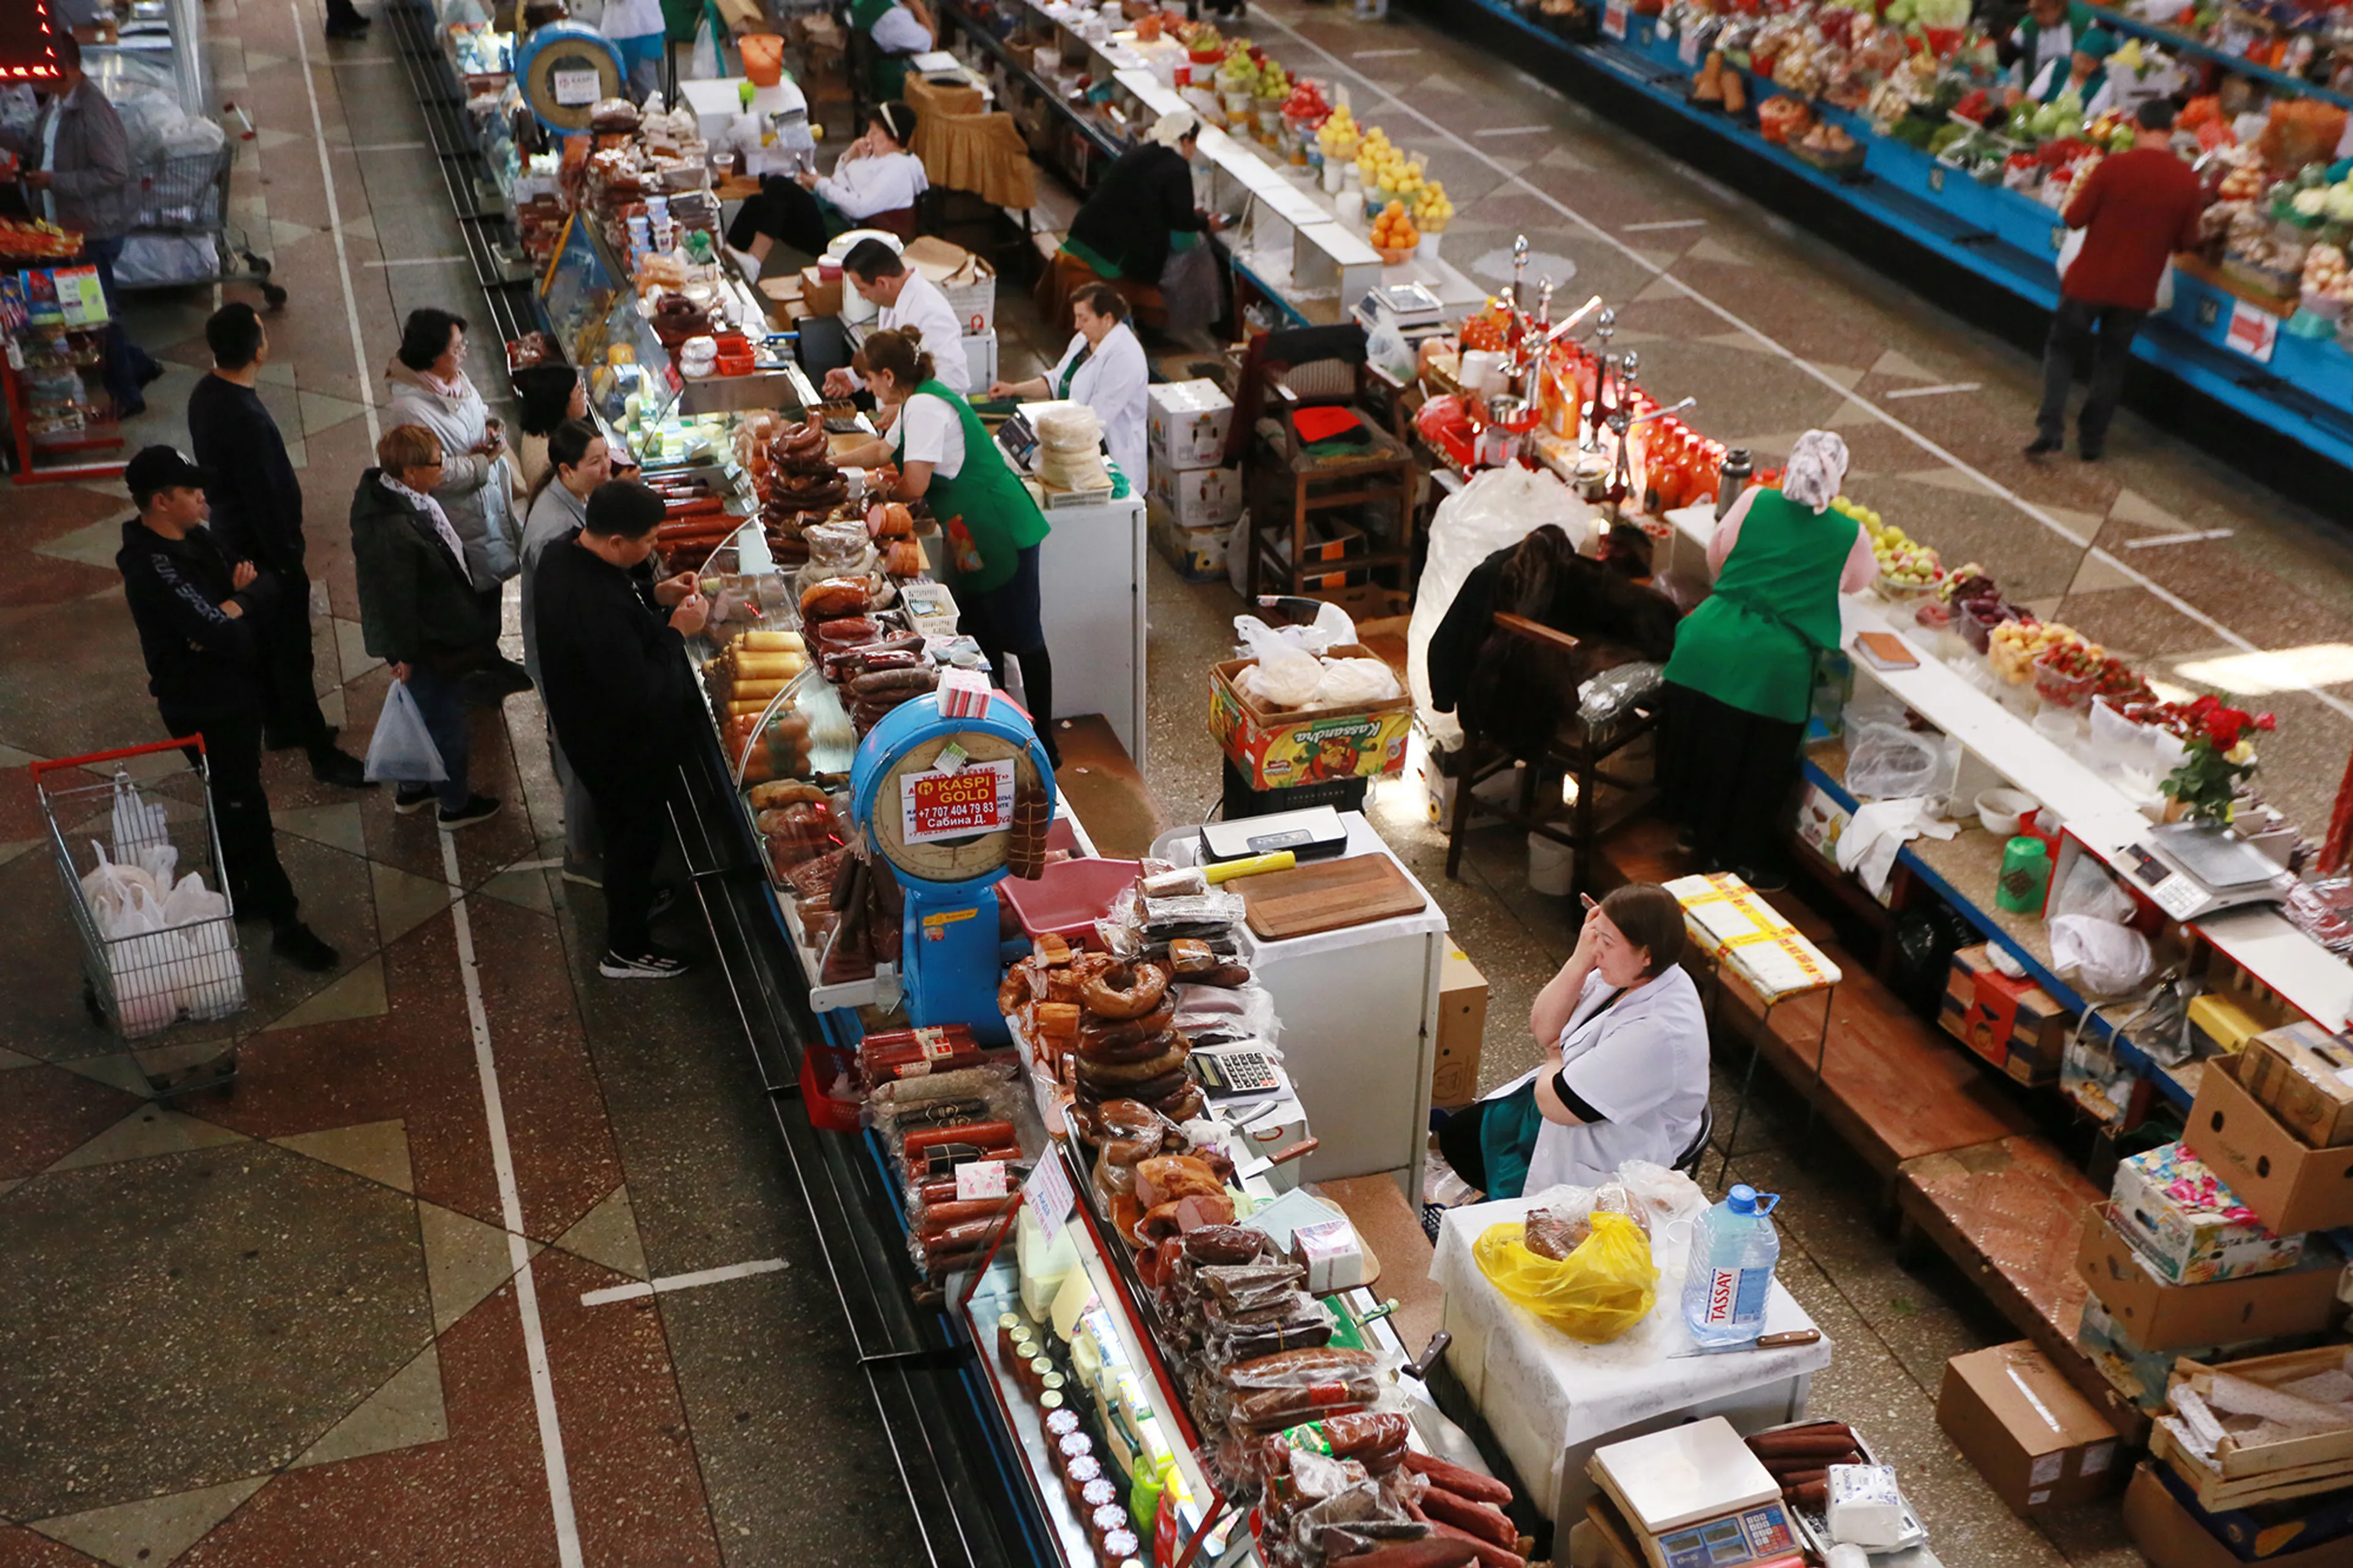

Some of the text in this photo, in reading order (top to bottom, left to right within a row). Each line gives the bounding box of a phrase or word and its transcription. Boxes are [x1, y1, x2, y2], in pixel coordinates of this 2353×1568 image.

[175, 582, 229, 624] SPORT
[1295, 721, 1381, 743] Kassandra
[938, 776, 990, 792] KASPI
[939, 789, 989, 803] GOLD
[919, 809, 930, 818] +7
[932, 806, 949, 817] 707
[951, 805, 968, 816] 404
[969, 803, 980, 814] 79
[983, 801, 995, 812] 83
[927, 816, 972, 827] Сабина
[974, 814, 987, 825] Д.
[1711, 1271, 1732, 1322] TASSAY
